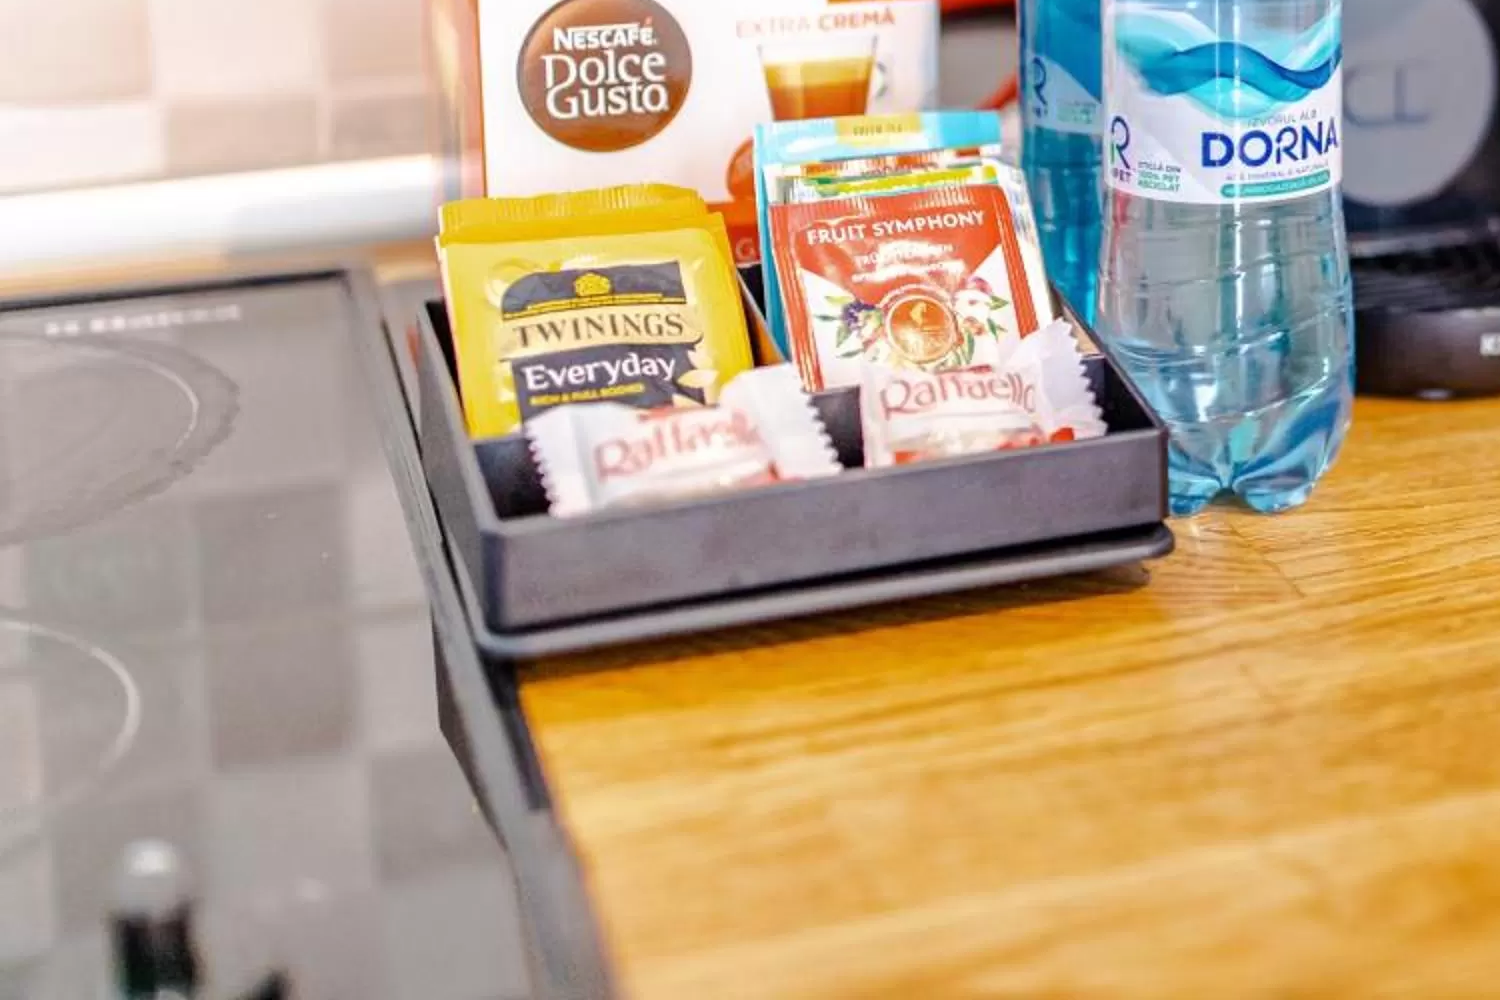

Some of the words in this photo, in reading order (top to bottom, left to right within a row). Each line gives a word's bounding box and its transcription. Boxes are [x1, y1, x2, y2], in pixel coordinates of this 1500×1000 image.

[736, 15, 811, 38] EXTRA
[541, 49, 666, 88] Dolce
[546, 79, 669, 119] Gusto
[1201, 116, 1339, 168] DORNA
[806, 224, 866, 246] FRUIT
[873, 210, 986, 237] SYMPHONY
[514, 313, 684, 347] TWININGS
[523, 352, 677, 390] Everyday
